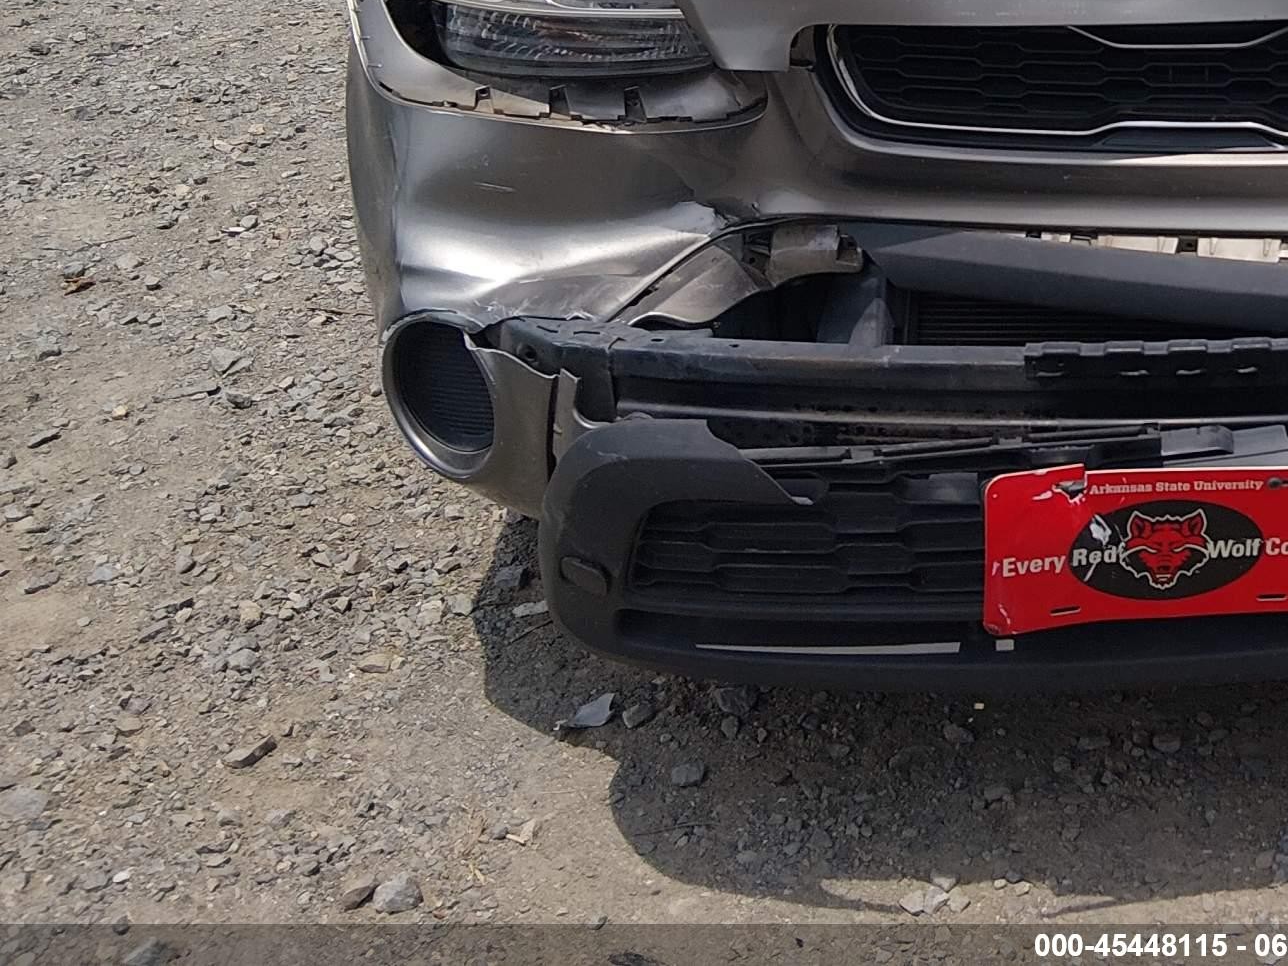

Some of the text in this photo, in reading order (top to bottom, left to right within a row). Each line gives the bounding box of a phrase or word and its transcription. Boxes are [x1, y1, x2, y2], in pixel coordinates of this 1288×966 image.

[1089, 479, 1264, 495] Arkansas State University
[1002, 556, 1066, 578] Every
[1072, 545, 1119, 567] Red
[1207, 538, 1262, 559] Wolf
